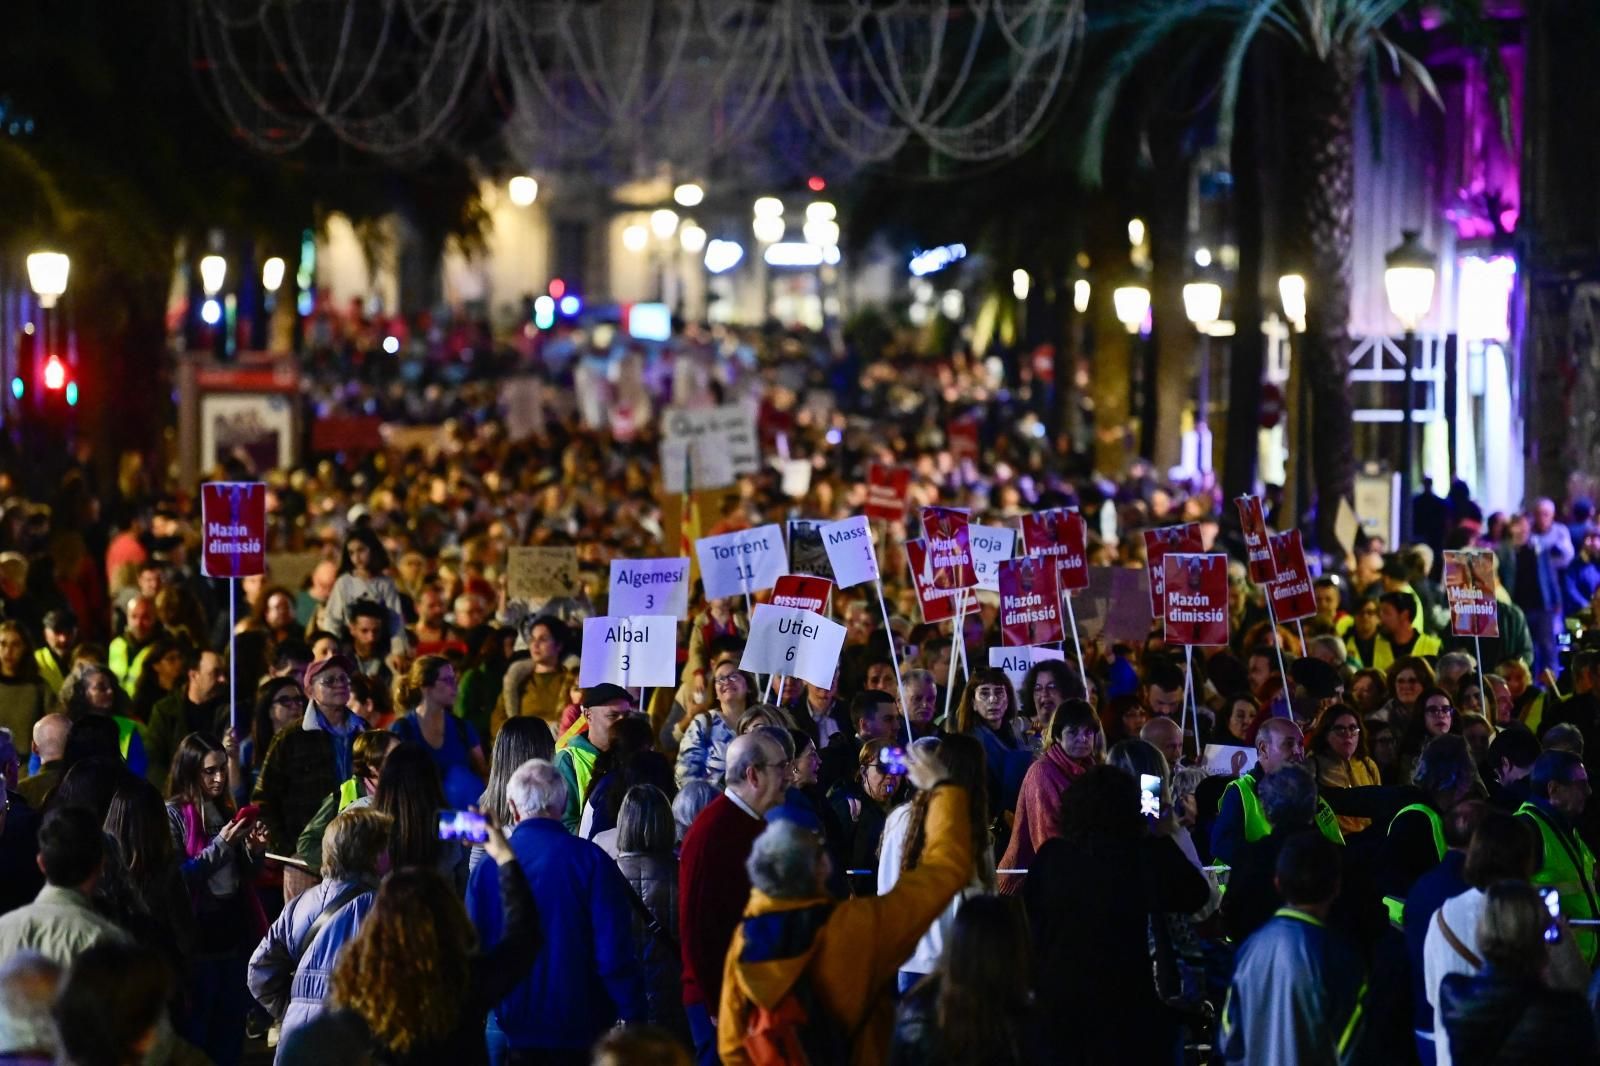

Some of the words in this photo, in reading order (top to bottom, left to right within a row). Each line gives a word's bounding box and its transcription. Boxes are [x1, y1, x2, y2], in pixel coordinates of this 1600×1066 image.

[710, 538, 769, 560] Torrent
[970, 537, 1002, 553] roja
[1057, 555, 1082, 570] ssió
[617, 567, 684, 588] Algemesí
[736, 564, 755, 580] 11
[1276, 568, 1297, 583] azón
[1273, 578, 1309, 600] dimissió
[1451, 586, 1483, 599] Mazón
[645, 594, 654, 609] 3
[1004, 592, 1041, 610] Mazón
[1169, 592, 1209, 606] Mazón
[1005, 606, 1056, 625] dimissió
[1169, 608, 1223, 622] dimissió
[1454, 601, 1493, 615] dimissió
[604, 626, 649, 643] Albal
[778, 618, 819, 640] Utiel
[785, 646, 796, 661] 6
[620, 655, 630, 670] 3
